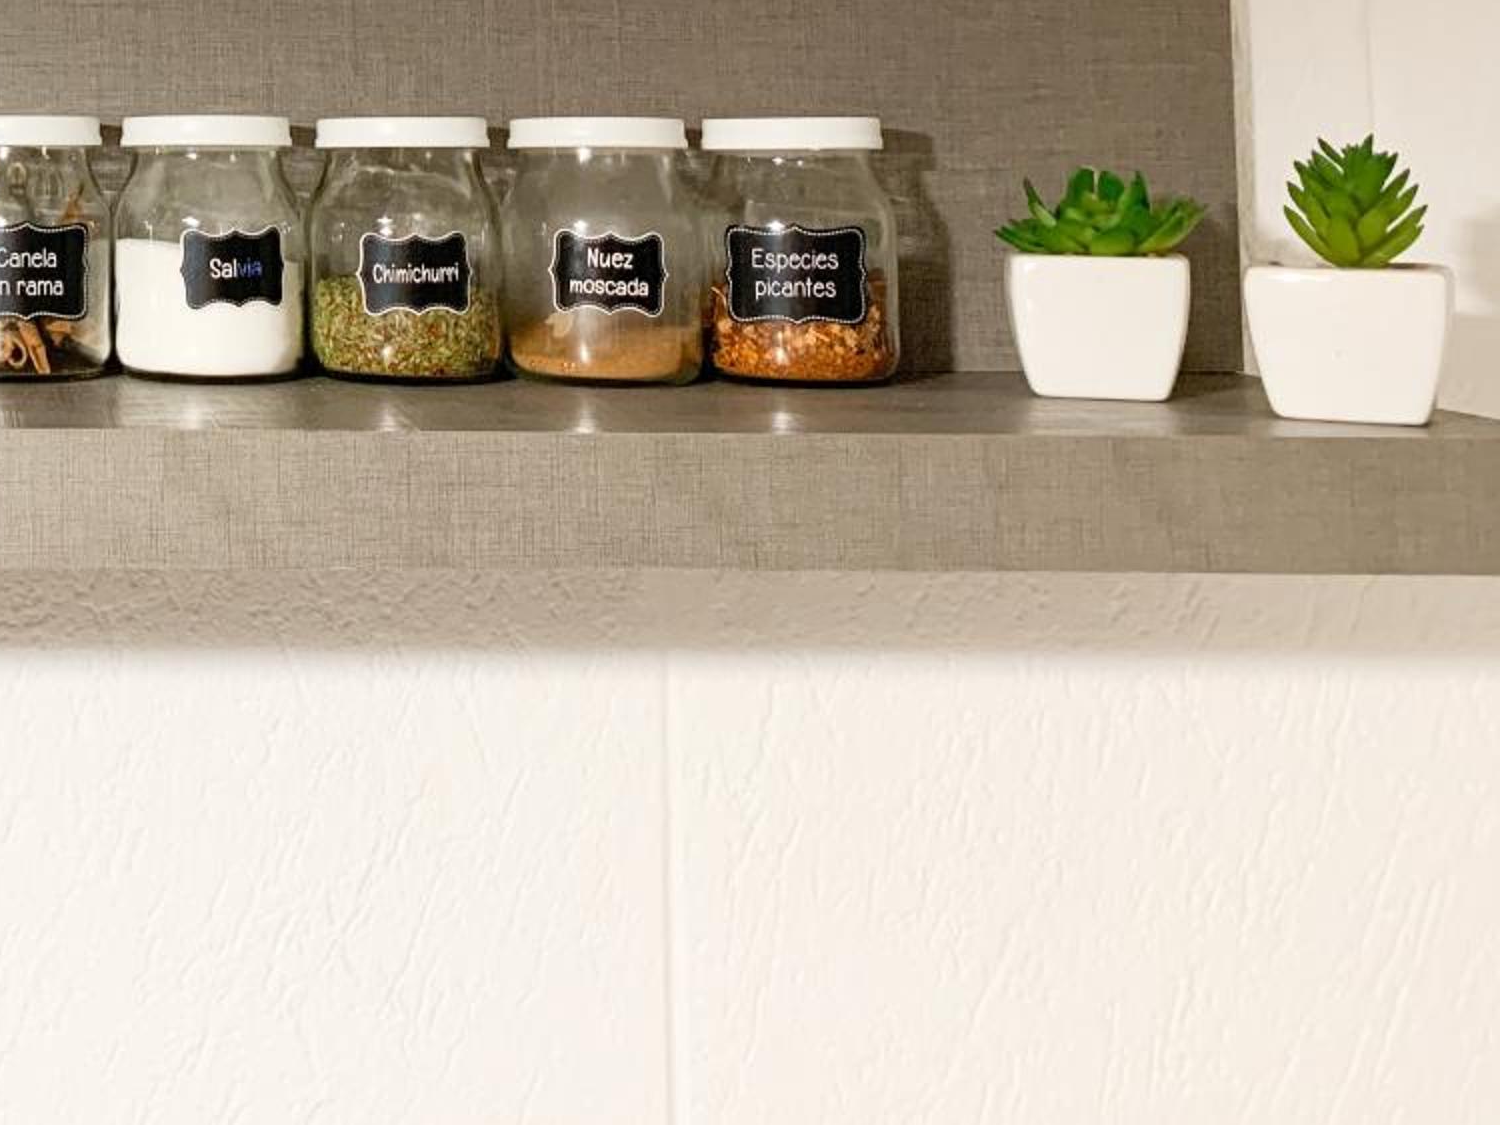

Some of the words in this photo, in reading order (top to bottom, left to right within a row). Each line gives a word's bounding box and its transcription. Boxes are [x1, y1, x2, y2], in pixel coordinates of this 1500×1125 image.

[587, 247, 634, 270] Nuez
[751, 248, 839, 275] Especies
[372, 262, 460, 284] Chimichurri
[16, 278, 65, 297] rama
[569, 277, 649, 297] moscada
[754, 278, 837, 301] picantes
